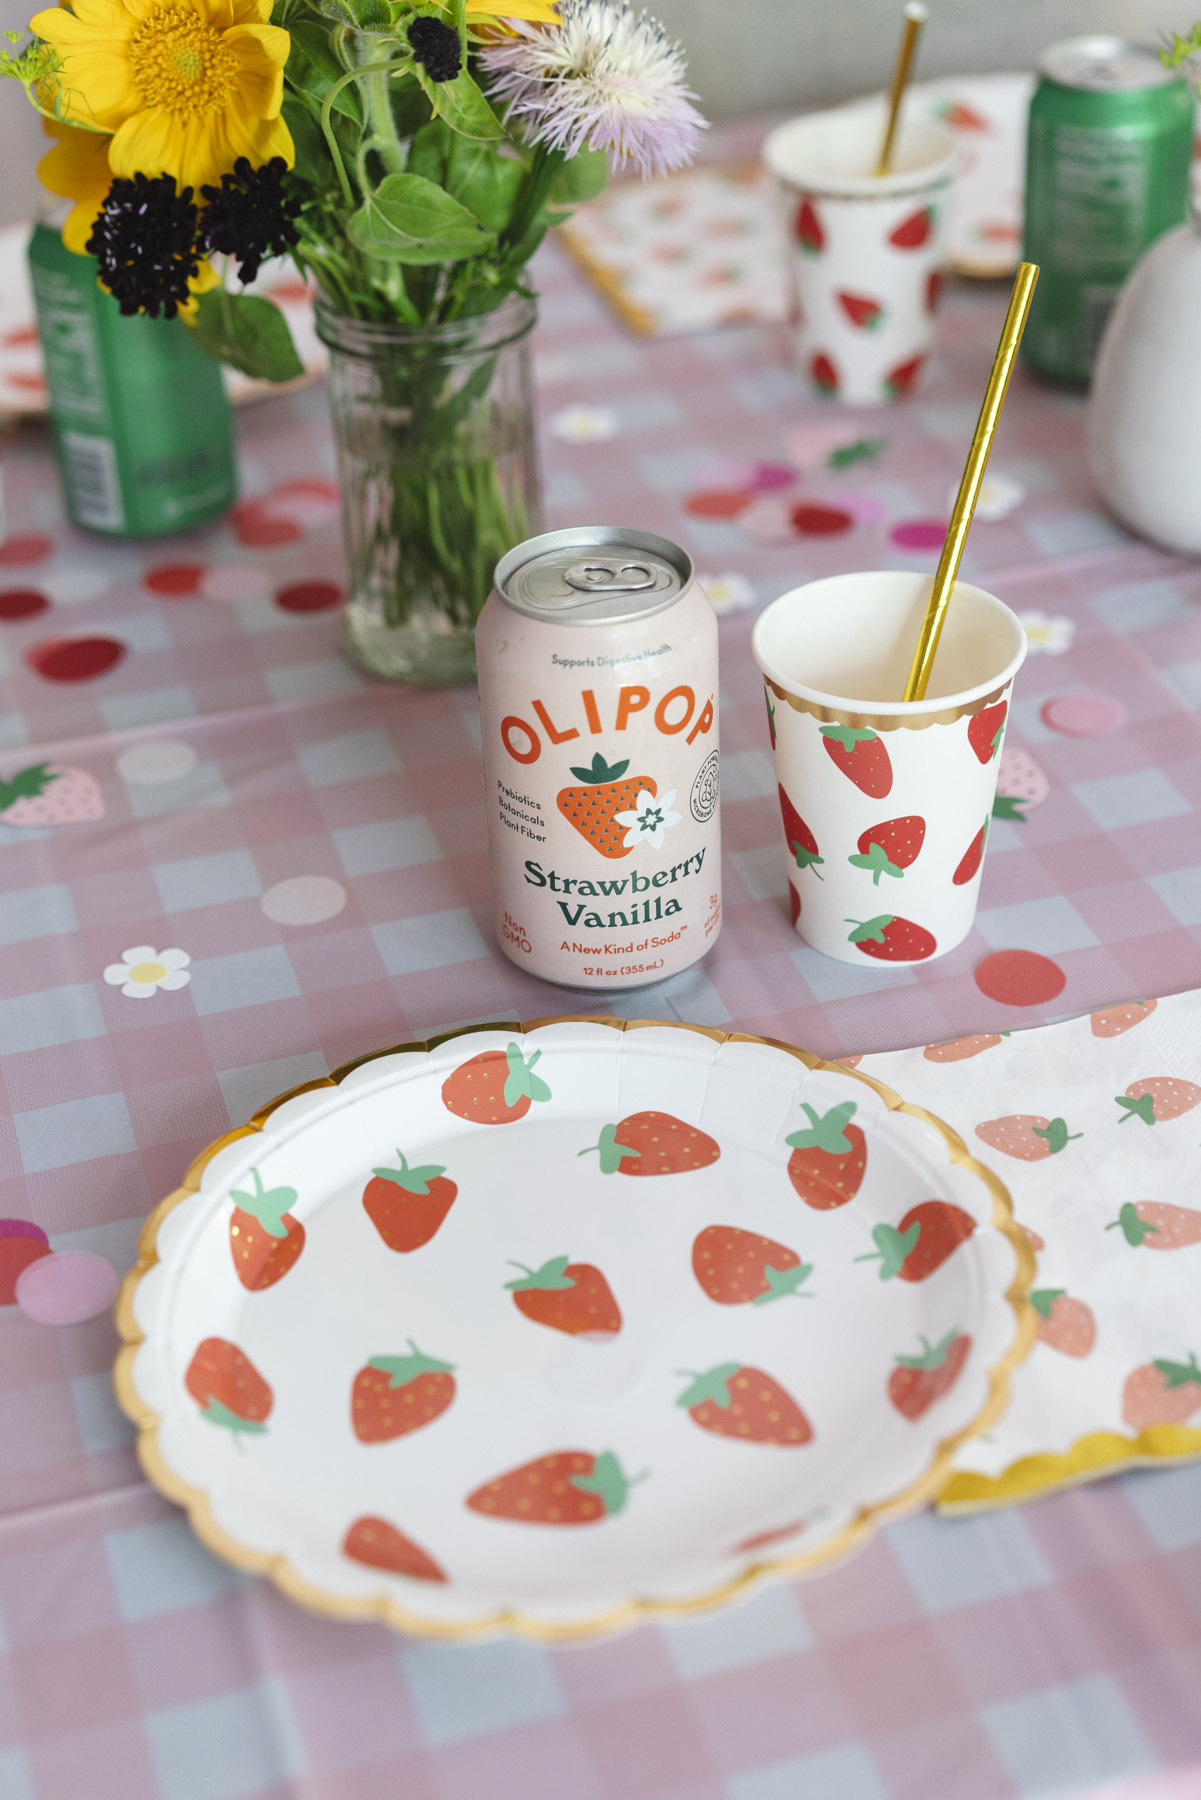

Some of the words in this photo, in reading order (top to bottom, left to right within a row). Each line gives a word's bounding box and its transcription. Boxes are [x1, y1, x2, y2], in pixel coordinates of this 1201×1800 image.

[551, 654, 595, 669] Supports
[597, 653, 643, 668] Digestive
[643, 643, 672, 659] Health
[500, 684, 714, 765] OLIPOP
[497, 779, 541, 810] Prebiotics
[498, 795, 545, 827] Botanicals
[499, 811, 519, 832] Plant
[520, 825, 546, 843] Fiber
[523, 847, 706, 897] Strawberry
[504, 911, 526, 937] Non
[556, 896, 682, 928] Vanilla
[502, 924, 532, 953] GMO
[560, 941, 571, 952] A
[572, 942, 602, 955] New
[604, 942, 634, 955] Kind
[636, 939, 649, 952] of
[583, 967, 594, 976] 12
[596, 967, 603, 976] fl
[620, 964, 645, 976] (355
[646, 958, 665, 972] mL)
